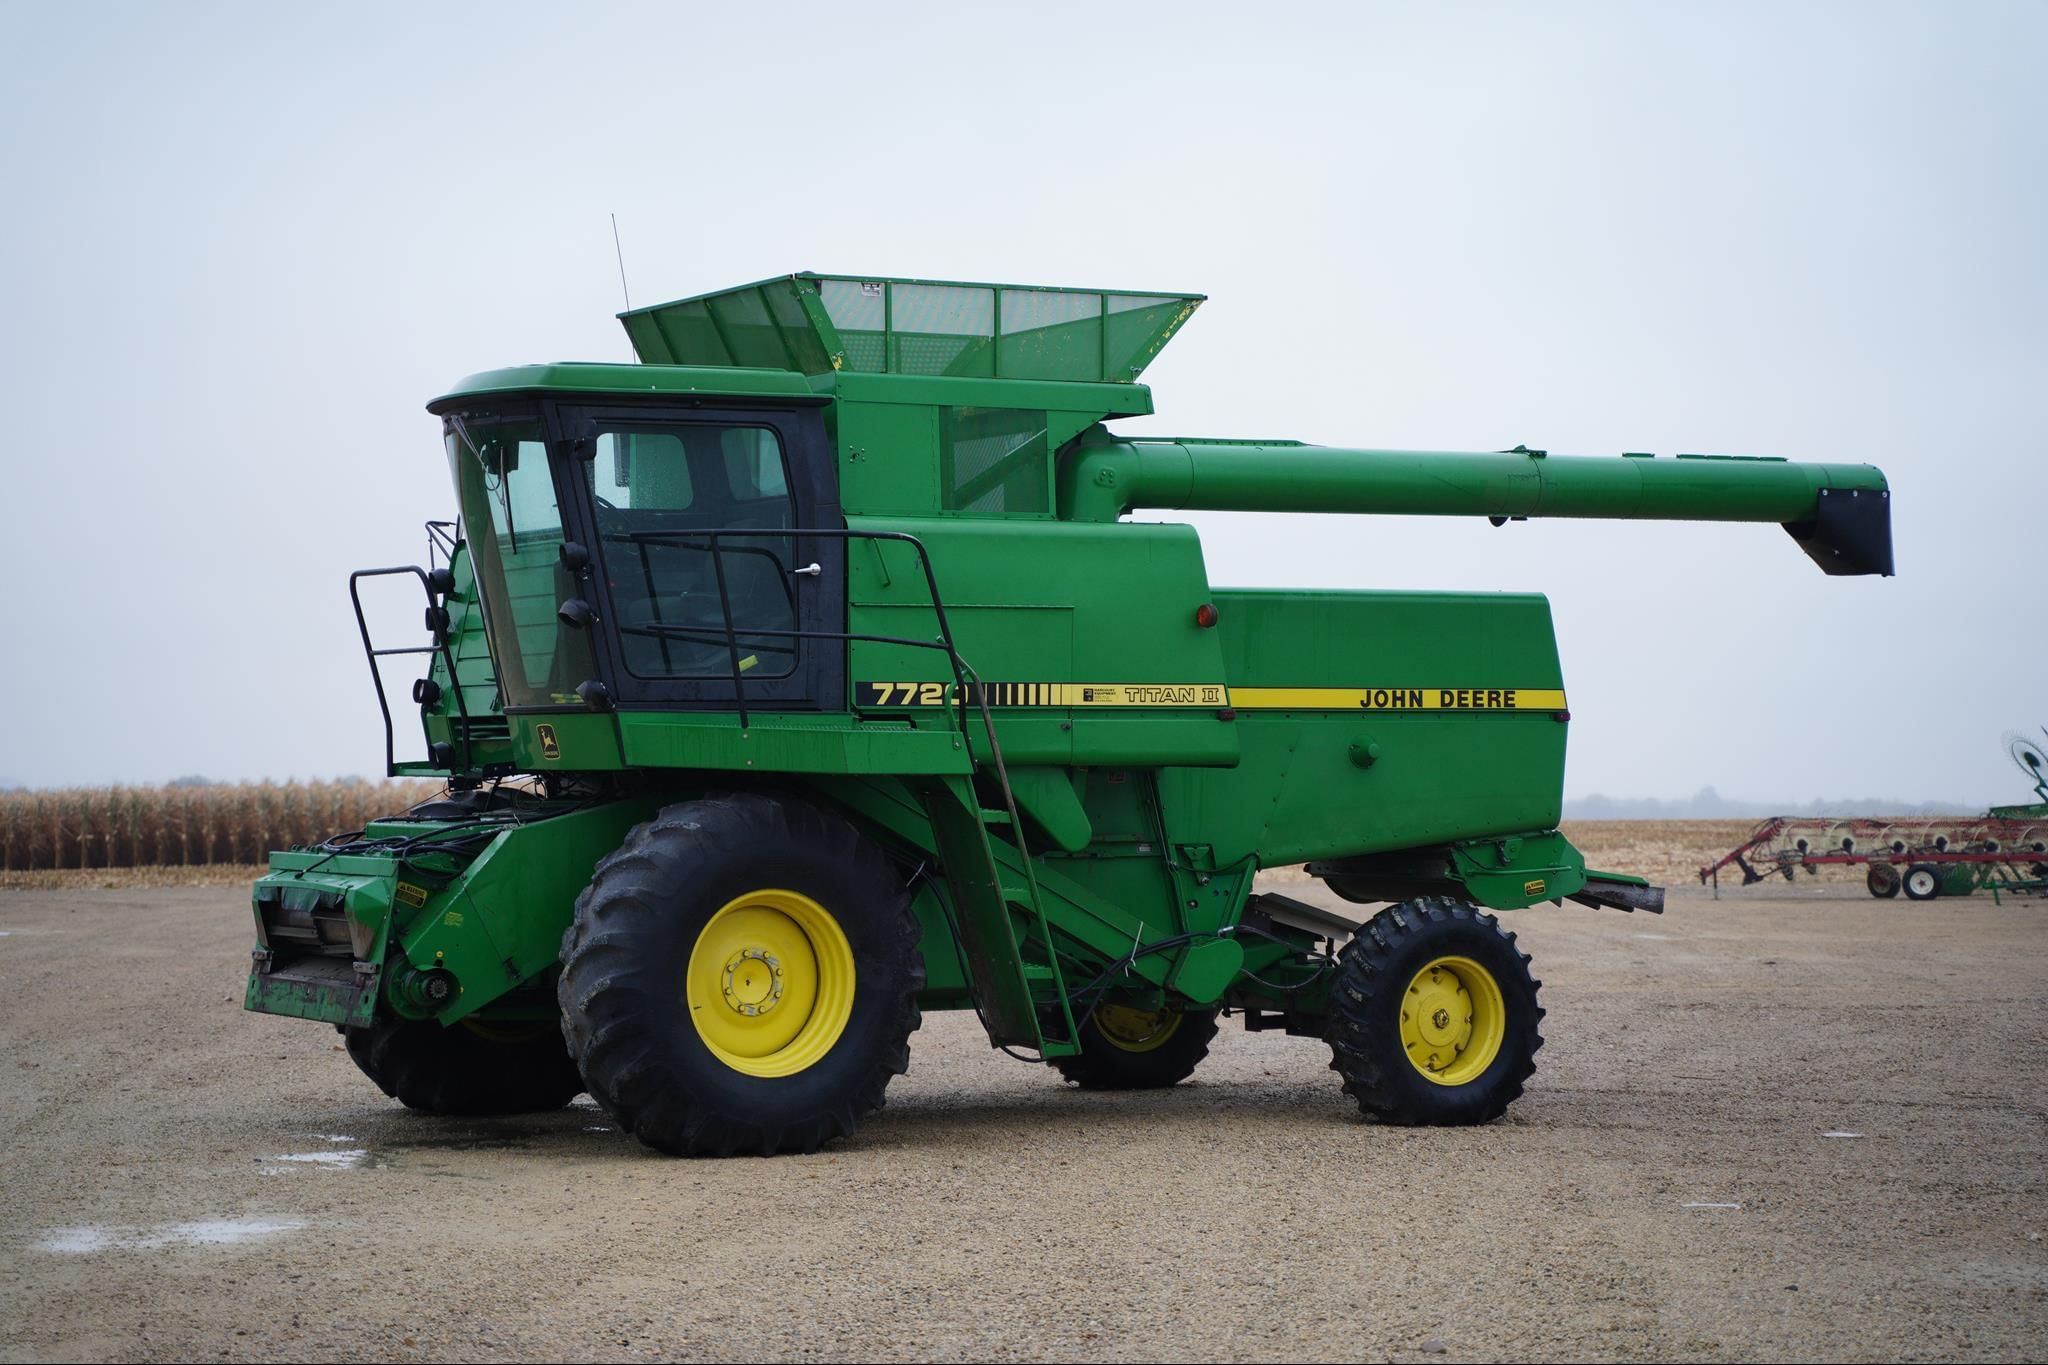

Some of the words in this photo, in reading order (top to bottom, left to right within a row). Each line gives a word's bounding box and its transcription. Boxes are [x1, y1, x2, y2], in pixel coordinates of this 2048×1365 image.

[1124, 687, 1195, 703] TITAN
[1202, 687, 1219, 703] II
[1359, 689, 1423, 708] JOHN
[1440, 690, 1516, 708] DEERE
